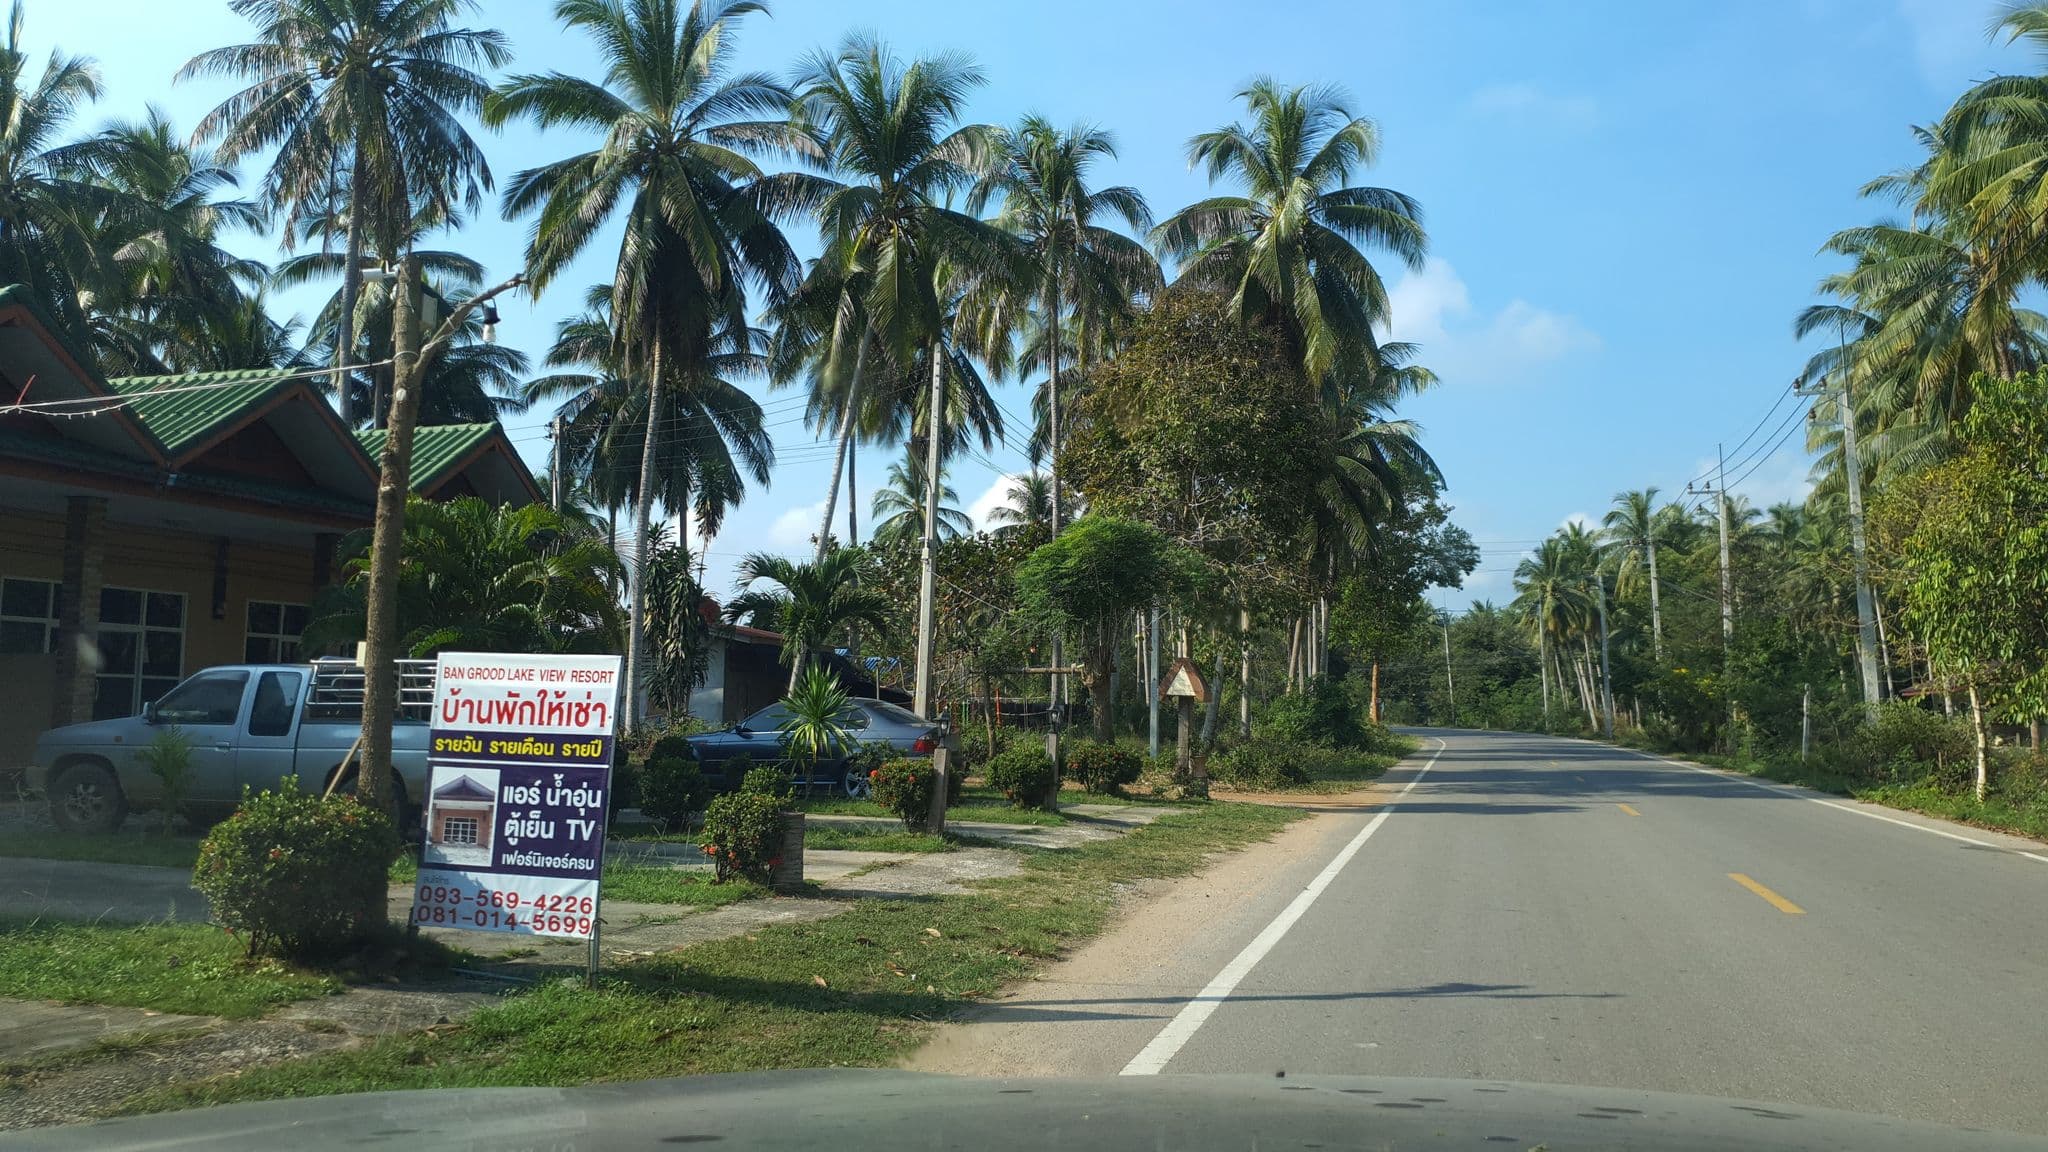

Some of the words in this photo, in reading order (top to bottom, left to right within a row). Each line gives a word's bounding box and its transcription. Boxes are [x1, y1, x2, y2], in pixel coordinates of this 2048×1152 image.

[443, 666, 464, 680] BAN
[468, 667, 505, 681] GROOD
[508, 668, 535, 682] LAKE
[539, 669, 566, 682] VIEW
[571, 670, 614, 684] RESORT
[442, 687, 607, 728] บ้านพักให้เช่า
[435, 735, 482, 753] รายวัน
[489, 736, 554, 756] รายเดือน
[562, 739, 602, 757] รายปี
[503, 779, 542, 805] แอร์
[546, 773, 602, 816] น้ำอุ่น
[504, 810, 555, 846] ตู้เย็น
[566, 818, 596, 841] TV
[419, 885, 593, 915] 093-569-4226
[417, 904, 591, 934] 081-014-5699
